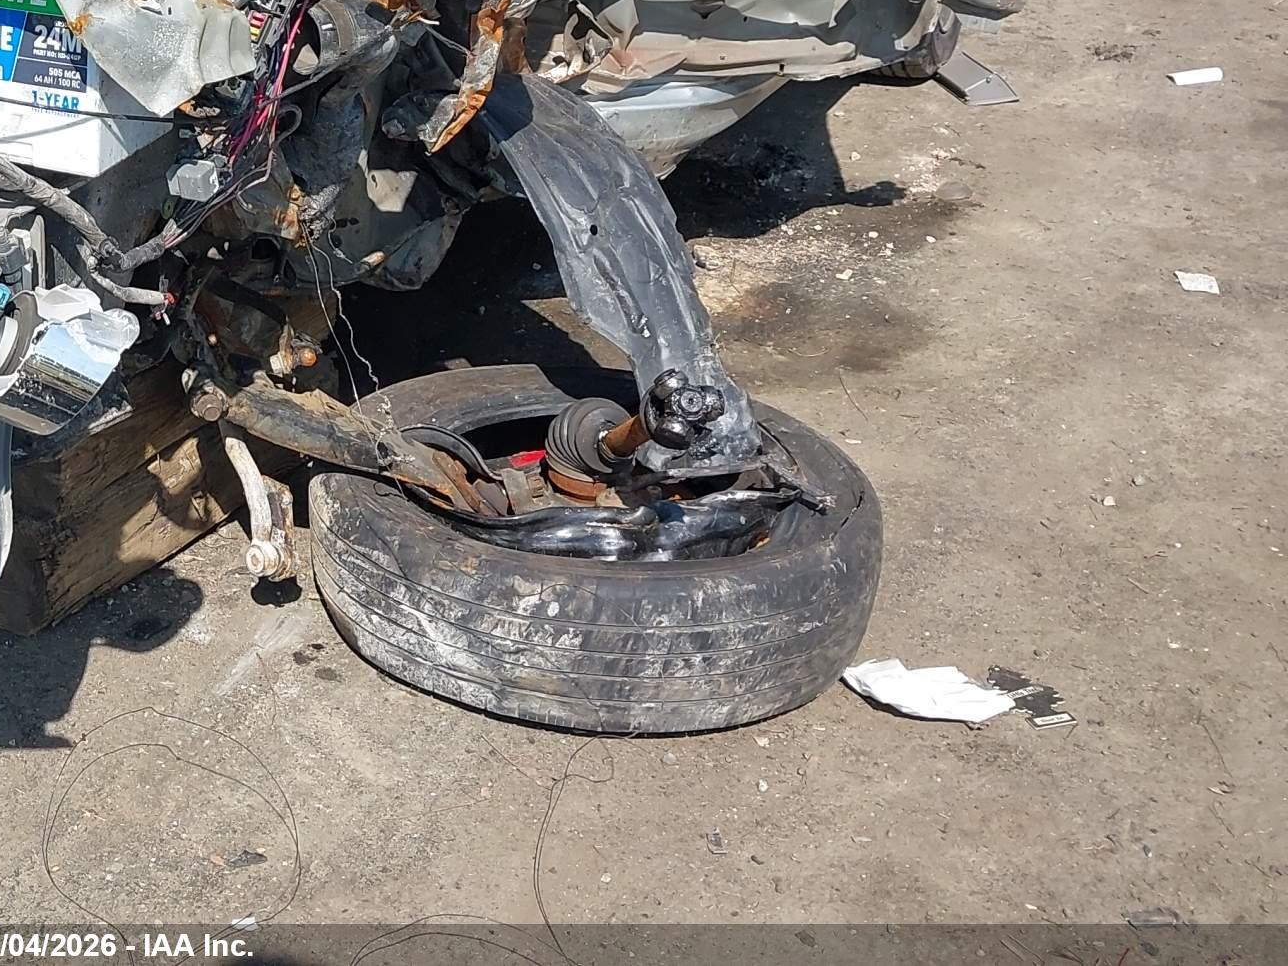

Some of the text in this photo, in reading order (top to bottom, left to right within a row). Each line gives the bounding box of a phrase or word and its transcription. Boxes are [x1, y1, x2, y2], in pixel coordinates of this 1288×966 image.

[34, 73, 43, 83] 64
[43, 76, 53, 85] AH
[58, 78, 71, 88] 100
[71, 80, 81, 90] RC
[48, 67, 81, 81] 505 MCA
[31, 90, 80, 111] 1-YEAR
